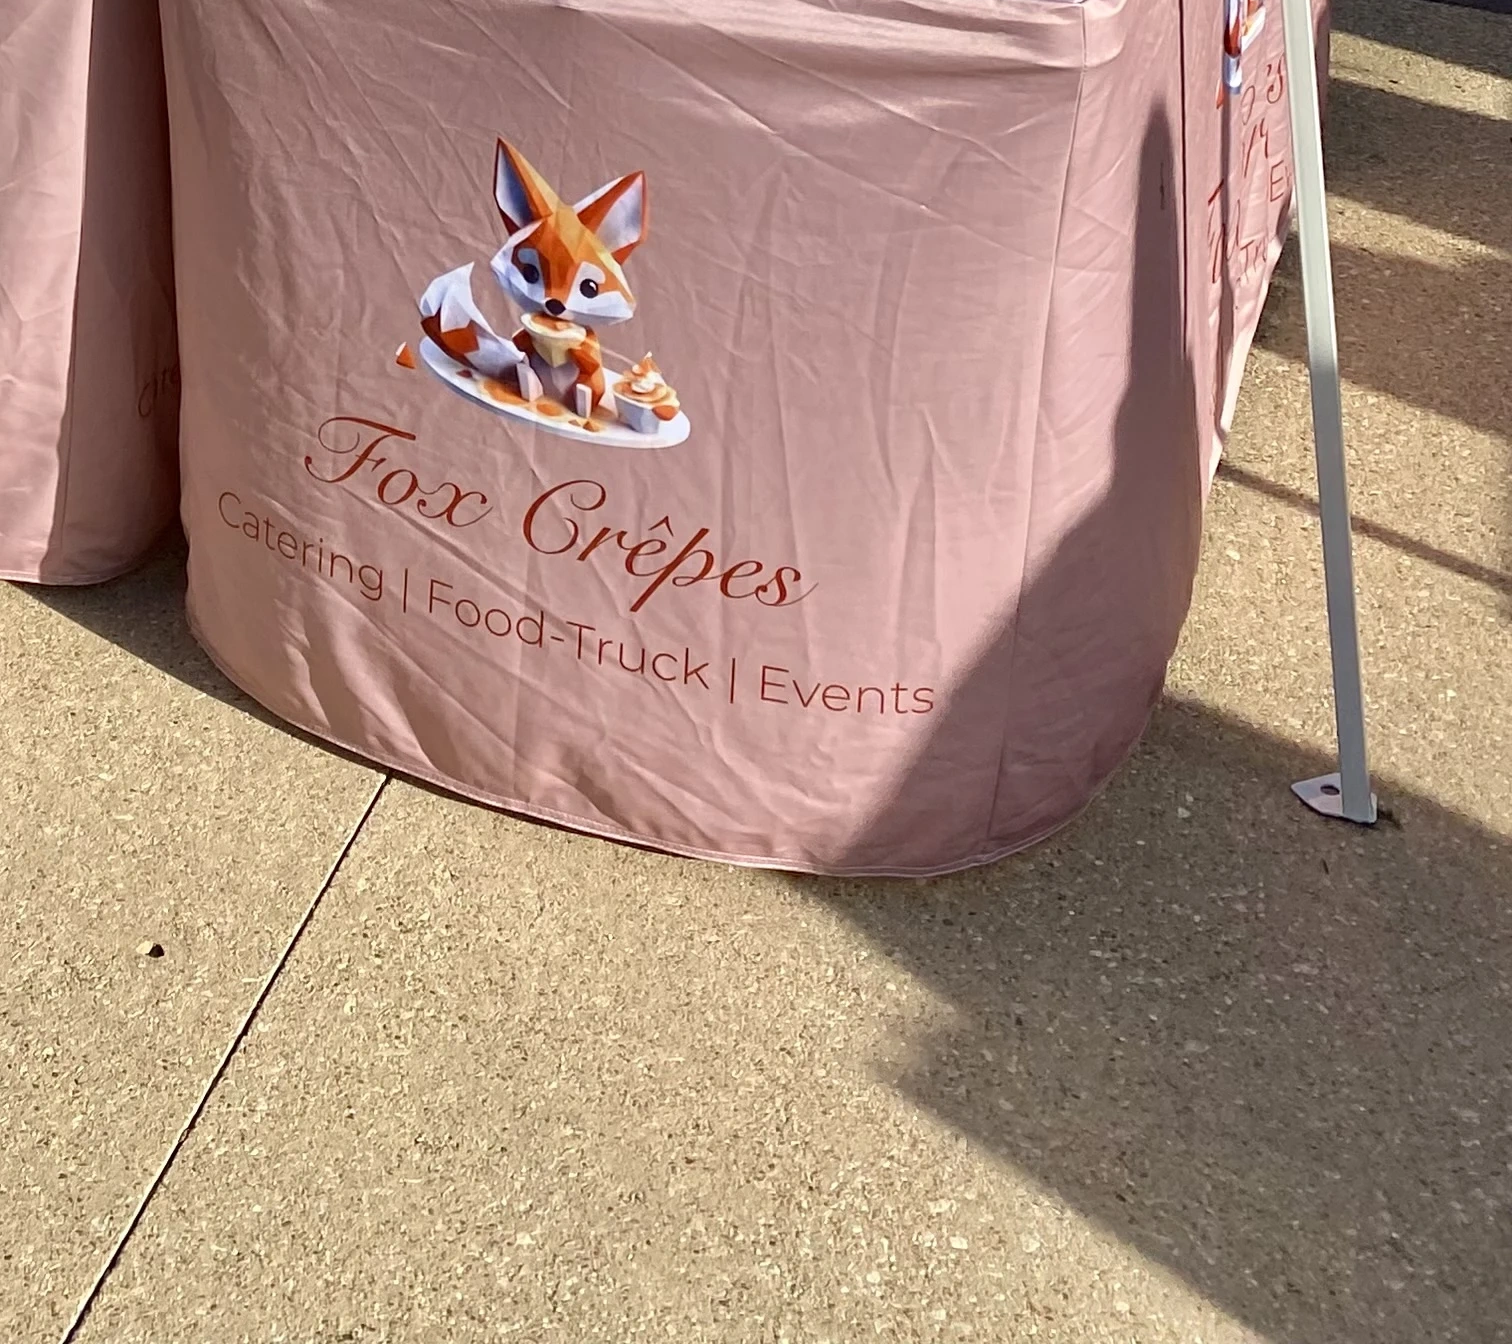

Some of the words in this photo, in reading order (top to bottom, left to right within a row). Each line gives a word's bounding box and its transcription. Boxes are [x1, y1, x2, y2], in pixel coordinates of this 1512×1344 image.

[217, 490, 386, 601] Catering
[428, 578, 710, 690] Food-Truck
[761, 665, 936, 715] Events
[304, 414, 495, 529] Fox
[521, 478, 819, 614] Crêpes
